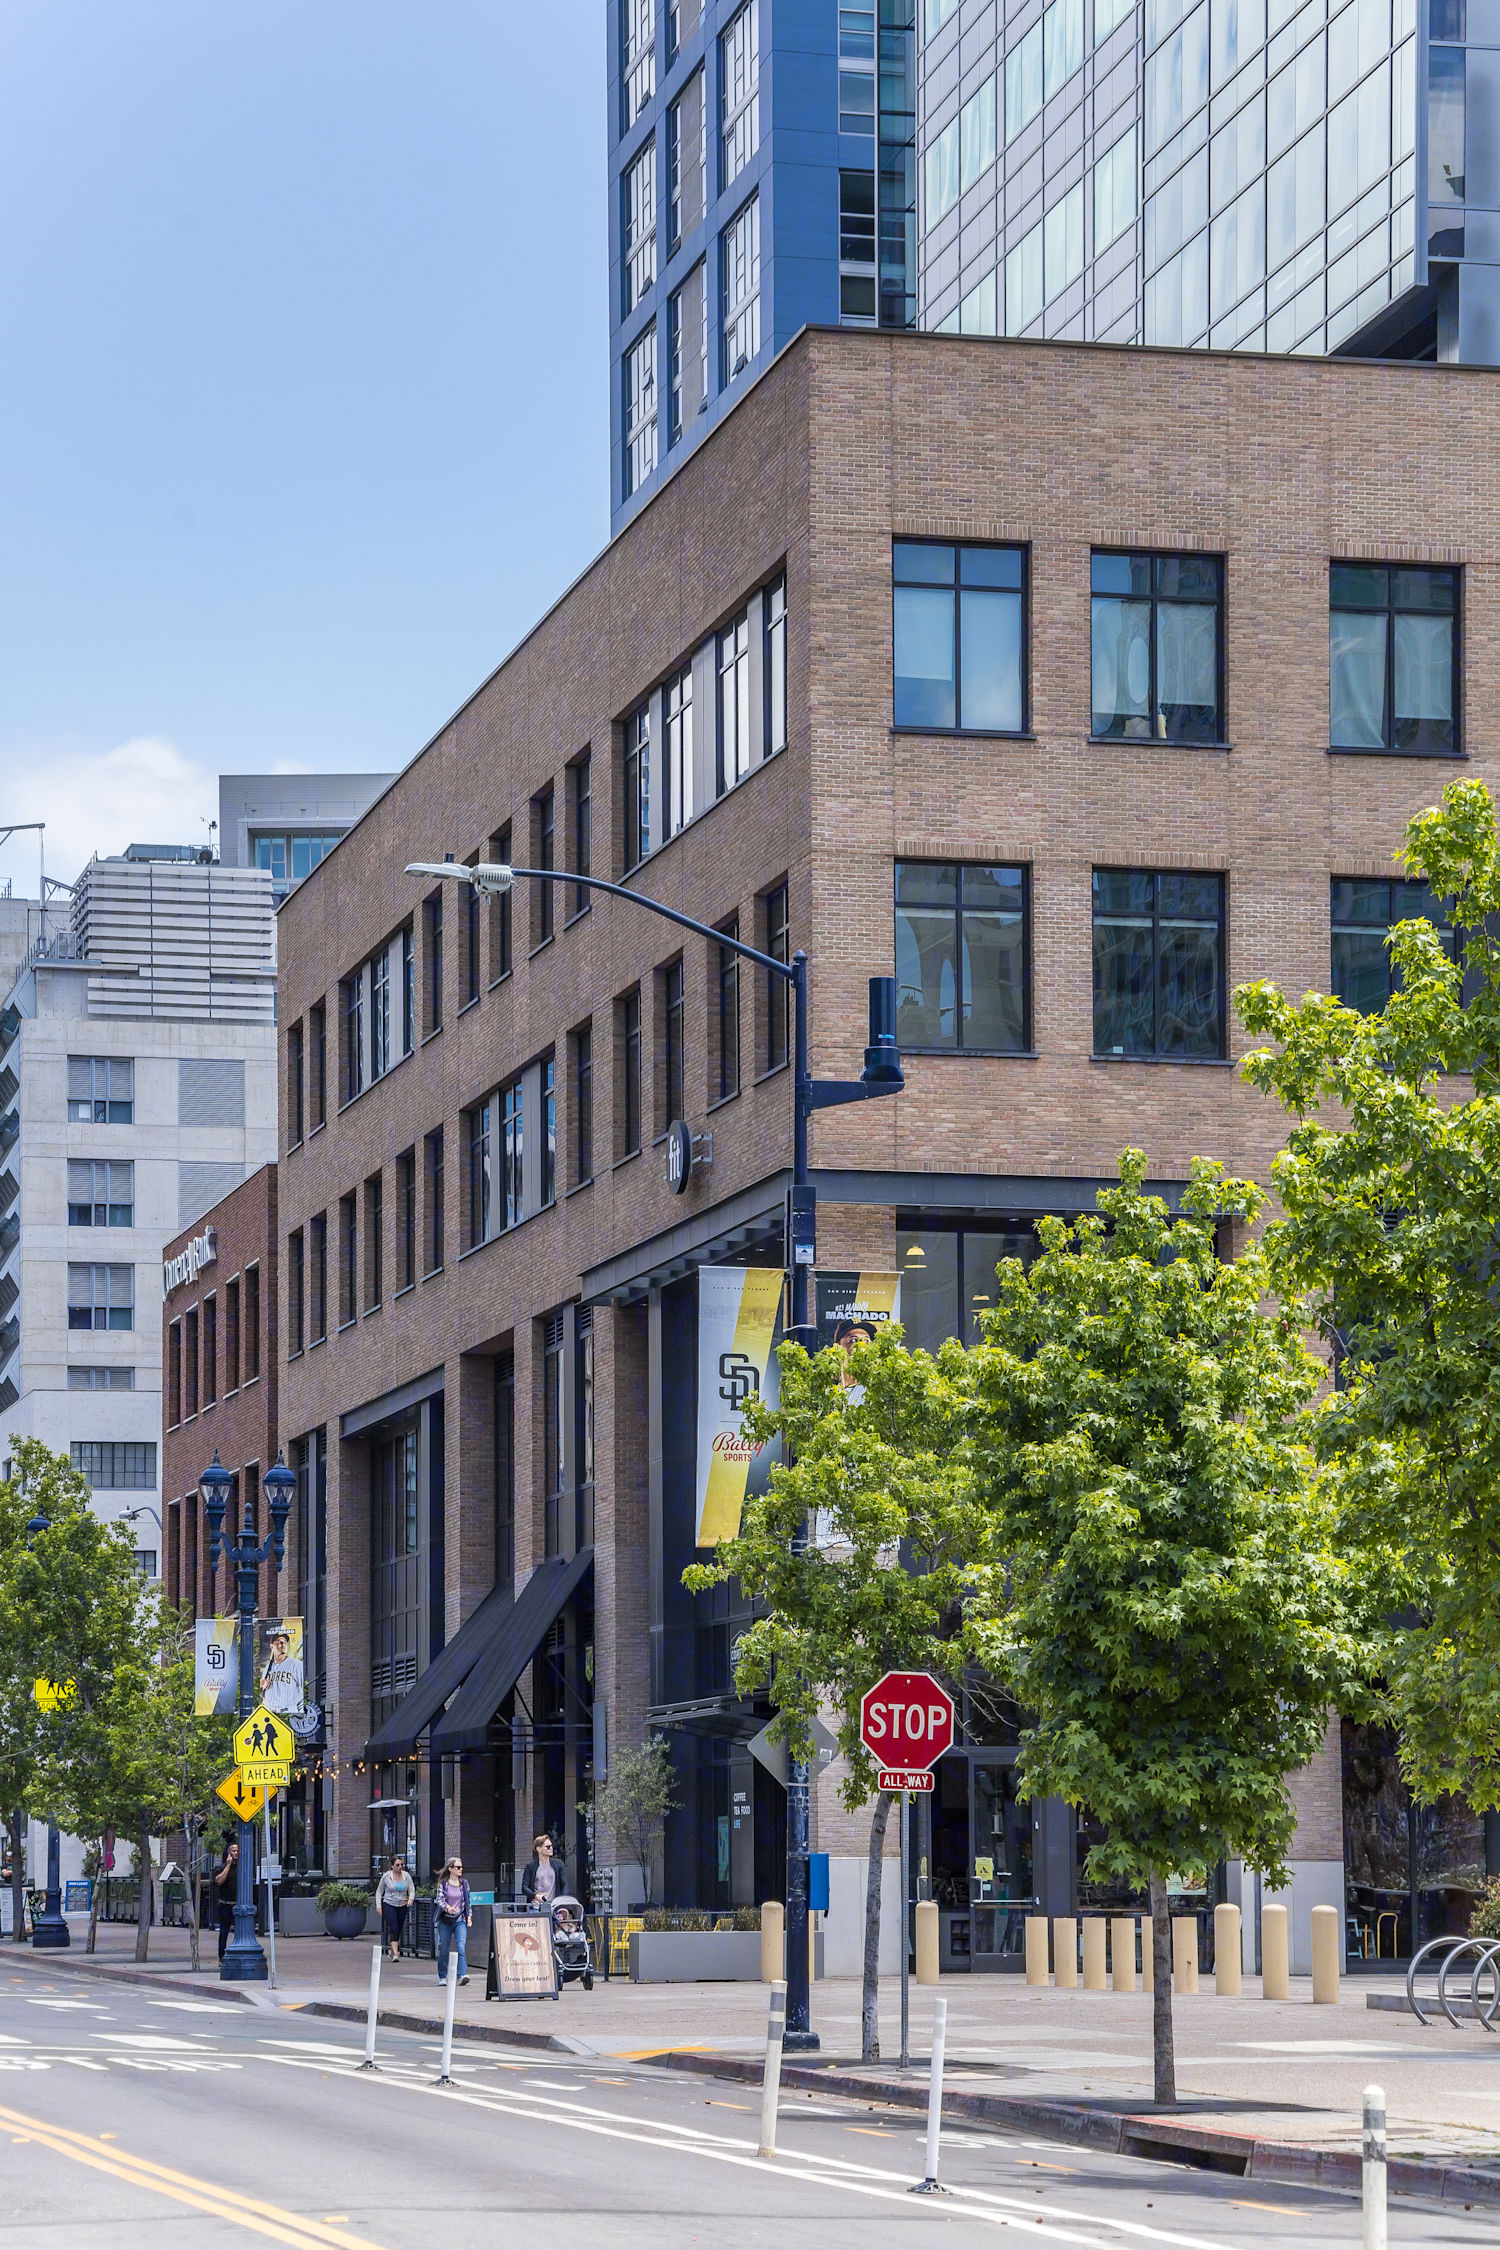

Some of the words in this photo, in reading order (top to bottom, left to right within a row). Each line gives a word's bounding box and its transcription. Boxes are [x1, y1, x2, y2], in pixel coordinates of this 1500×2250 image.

[826, 1311, 888, 1321] MACHADO
[719, 1353, 759, 1411] SD
[712, 1431, 765, 1458] Bally
[723, 1453, 752, 1462] SPORTS
[207, 1644, 225, 1669] SD
[203, 1677, 228, 1689] Bally
[867, 1702, 948, 1741] STOP
[247, 1768, 284, 1781] AHEAD
[884, 1775, 903, 1787] ALL
[907, 1775, 929, 1788] WAY
[733, 1792, 746, 1802] COFFEE
[741, 1805, 750, 1815] FOOD
